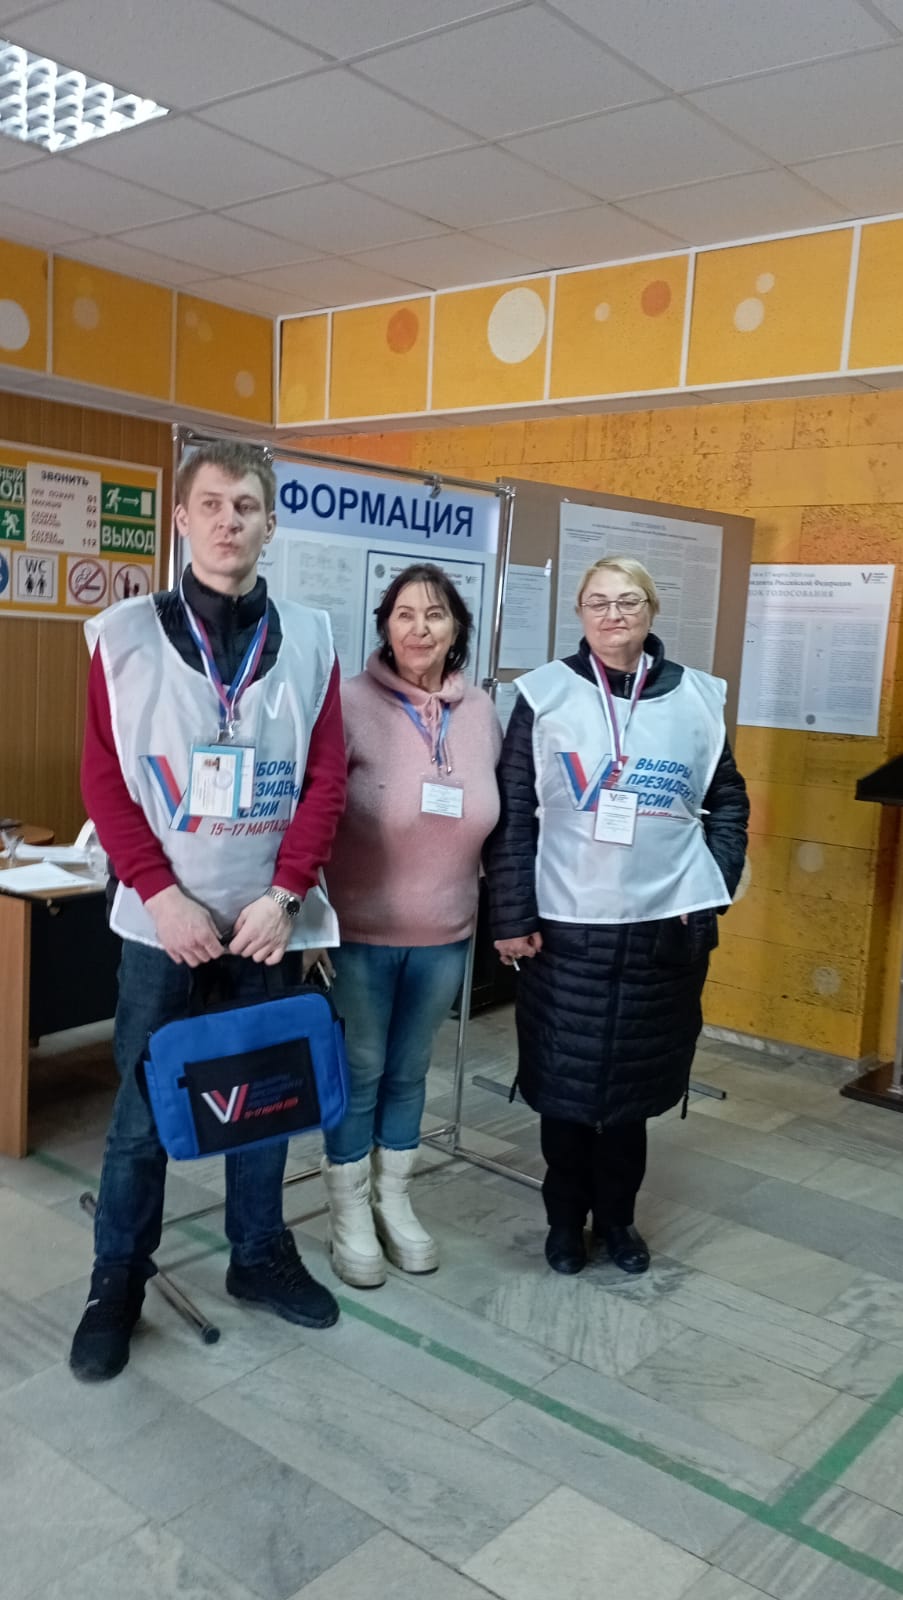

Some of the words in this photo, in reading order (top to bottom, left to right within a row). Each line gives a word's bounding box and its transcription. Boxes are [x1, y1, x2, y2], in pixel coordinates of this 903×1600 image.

[41, 470, 89, 487] ЗВОНИТЬ
[280, 479, 474, 538] ФОРМАЦИЯ
[102, 525, 155, 555] ВЫХОД
[25, 559, 47, 574] WC
[255, 760, 297, 777] БОРЫ
[635, 758, 693, 780] ВЫБОРЫ
